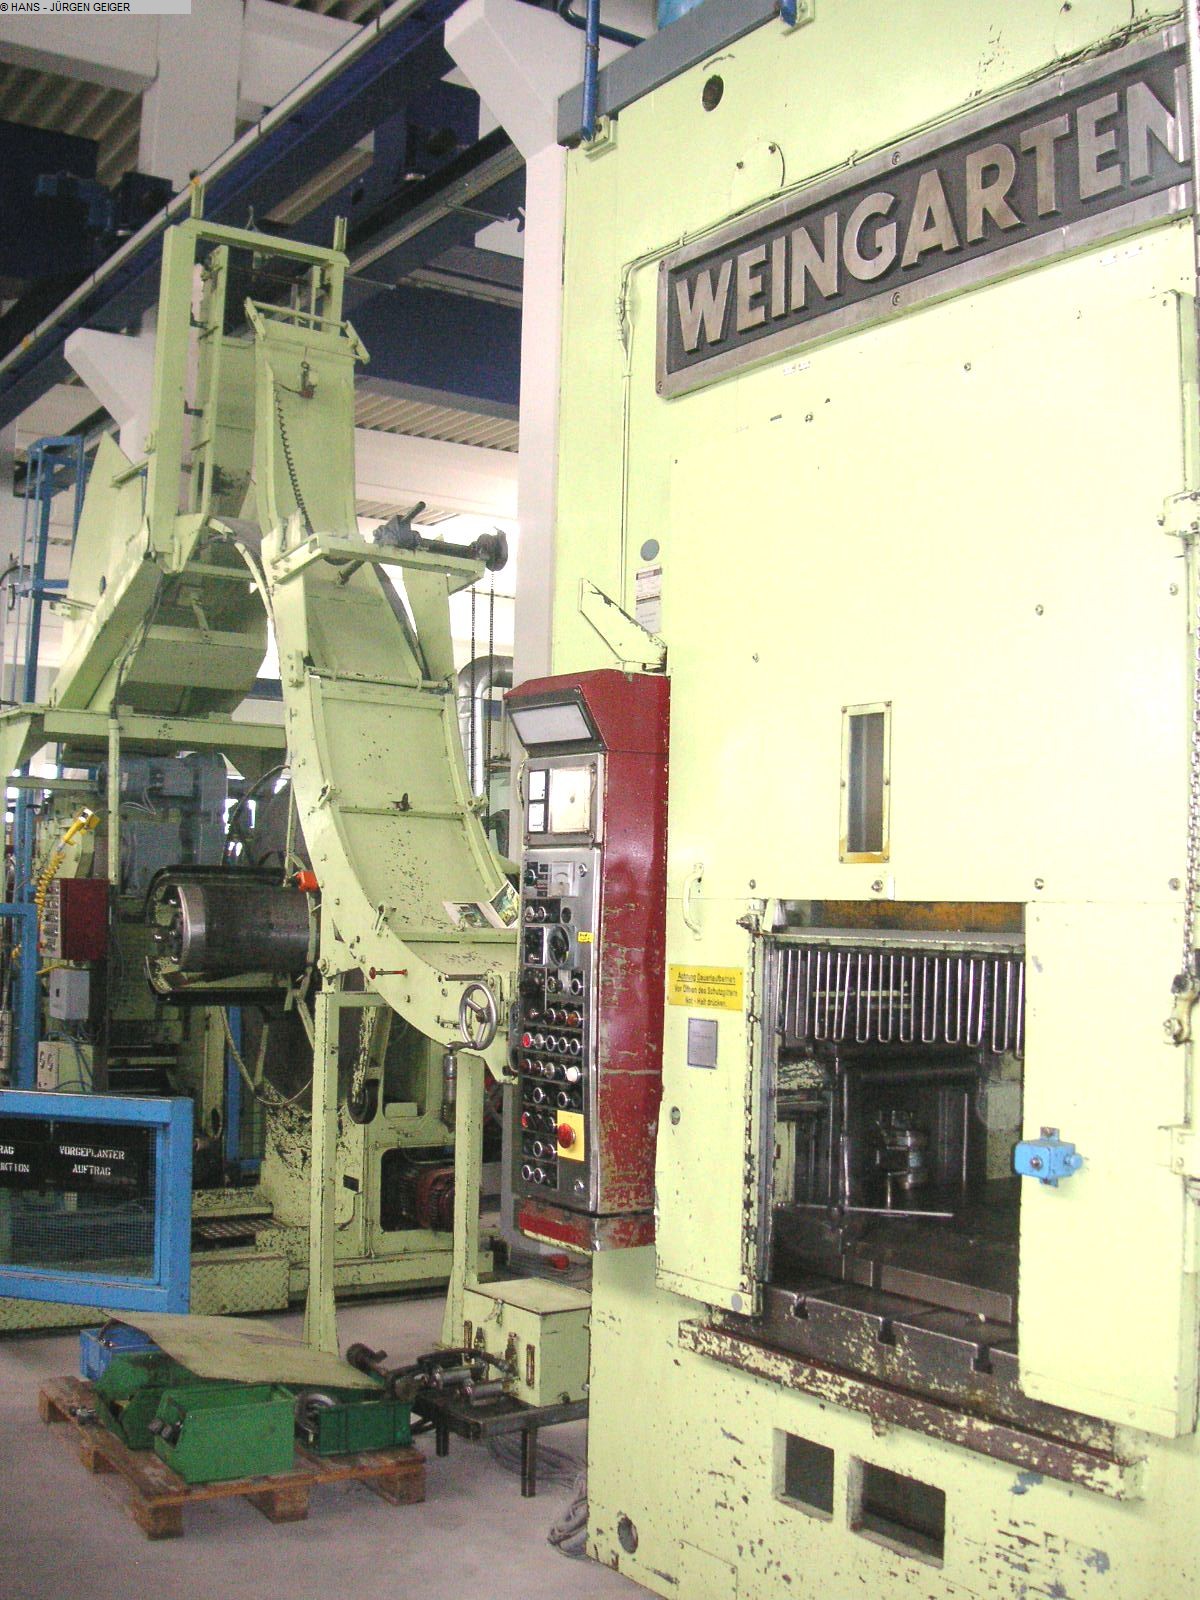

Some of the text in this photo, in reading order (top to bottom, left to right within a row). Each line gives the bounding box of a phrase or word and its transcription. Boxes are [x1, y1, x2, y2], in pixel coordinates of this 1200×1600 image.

[676, 64, 1191, 352] WEINGARTEN
[677, 972, 696, 982] Achtung
[59, 1145, 125, 1160] VORGEPLANTER
[72, 1163, 111, 1176] AUFTRAG
